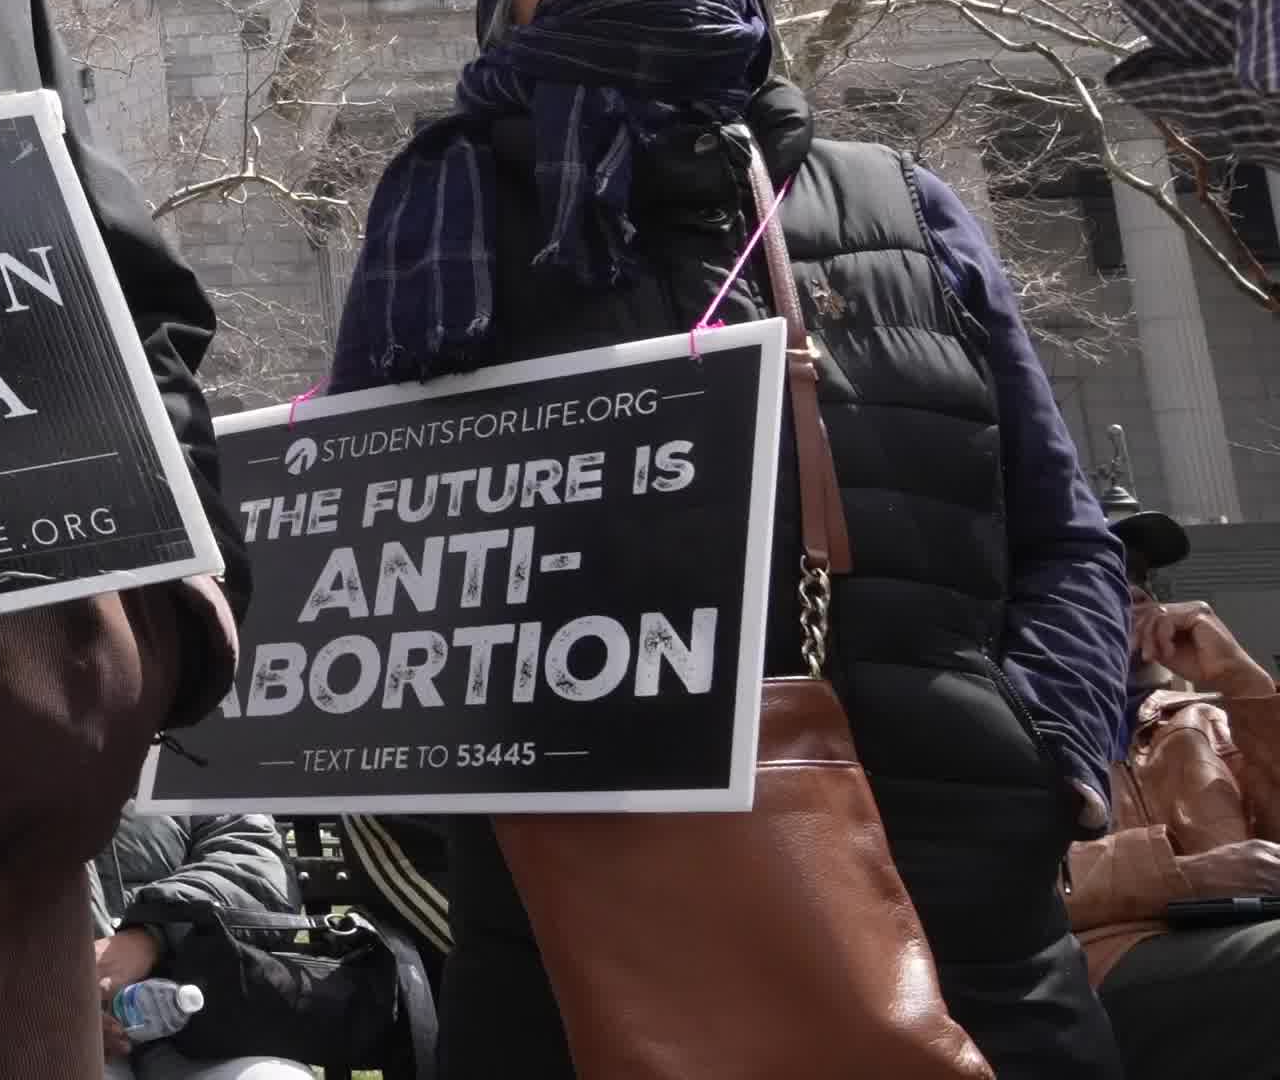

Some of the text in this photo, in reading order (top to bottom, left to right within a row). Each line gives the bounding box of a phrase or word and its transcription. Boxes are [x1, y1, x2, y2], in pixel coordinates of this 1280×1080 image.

[321, 388, 658, 463] STUDENTSFORLIFE.ORG
[239, 439, 696, 542] THE FUTURE IS
[297, 525, 582, 623] ANTI-
[303, 741, 537, 772] TEXT LIFE TO 53445
